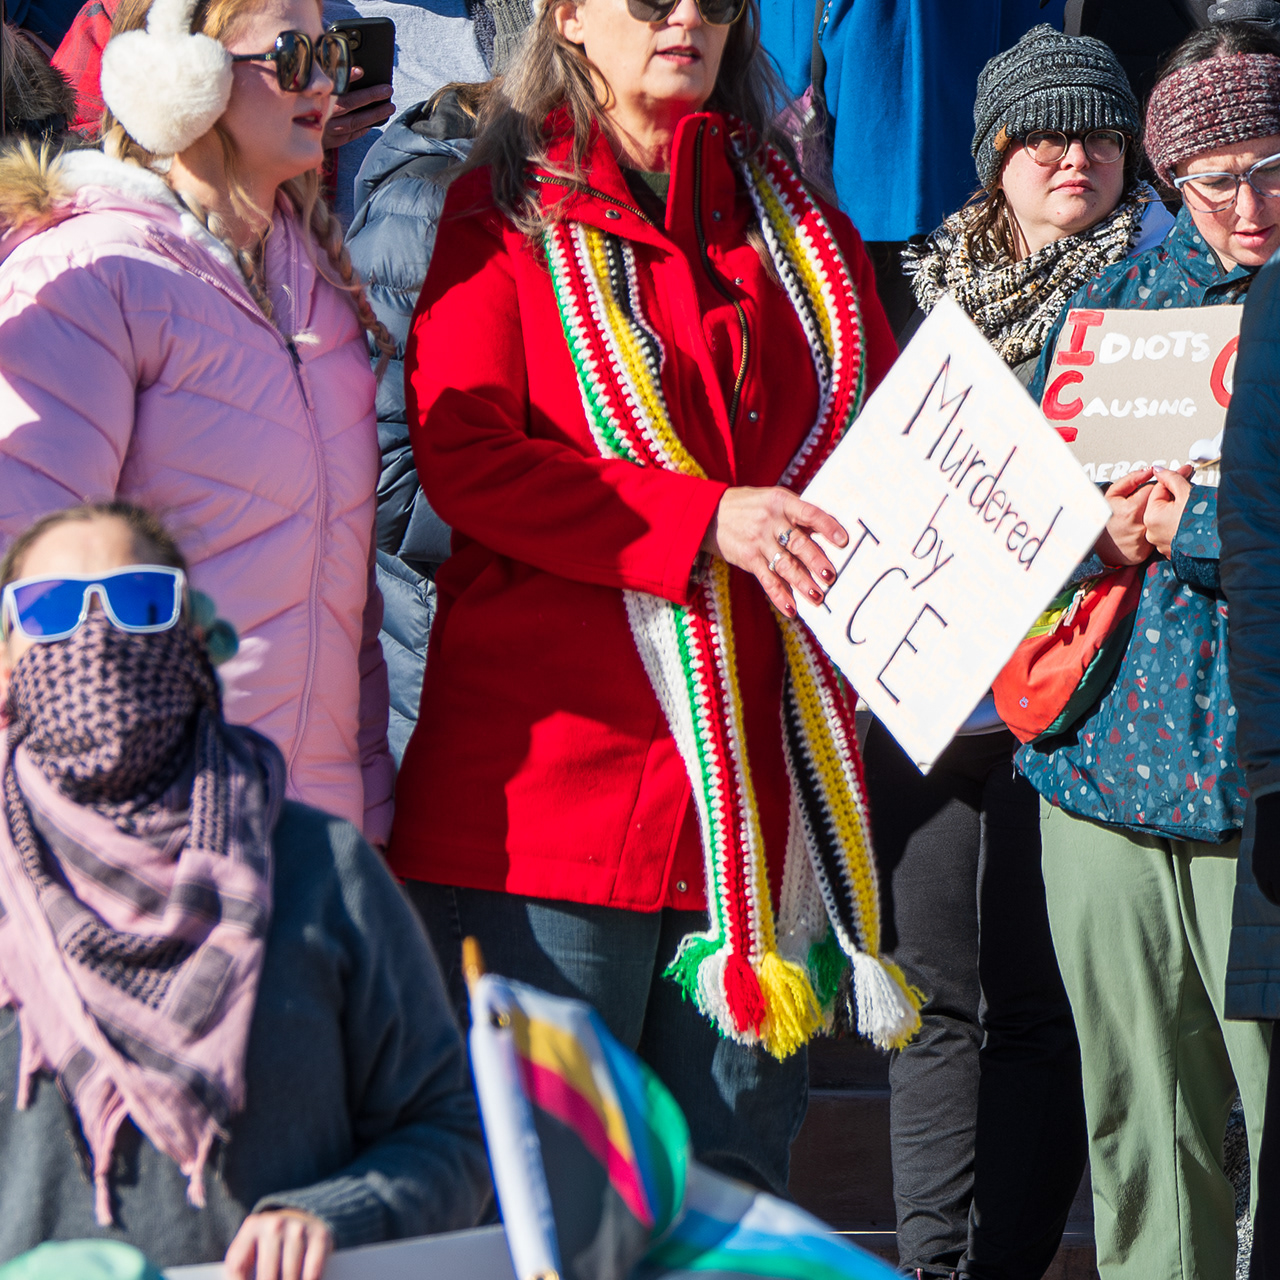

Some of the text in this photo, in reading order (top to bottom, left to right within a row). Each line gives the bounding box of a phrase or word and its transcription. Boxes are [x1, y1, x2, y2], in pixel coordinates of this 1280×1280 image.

[1056, 310, 1211, 366] IDIOTS
[1042, 370, 1197, 421] CAUSING
[901, 353, 1065, 572] Murdered
[911, 493, 954, 591] by
[821, 518, 948, 706] ICE
